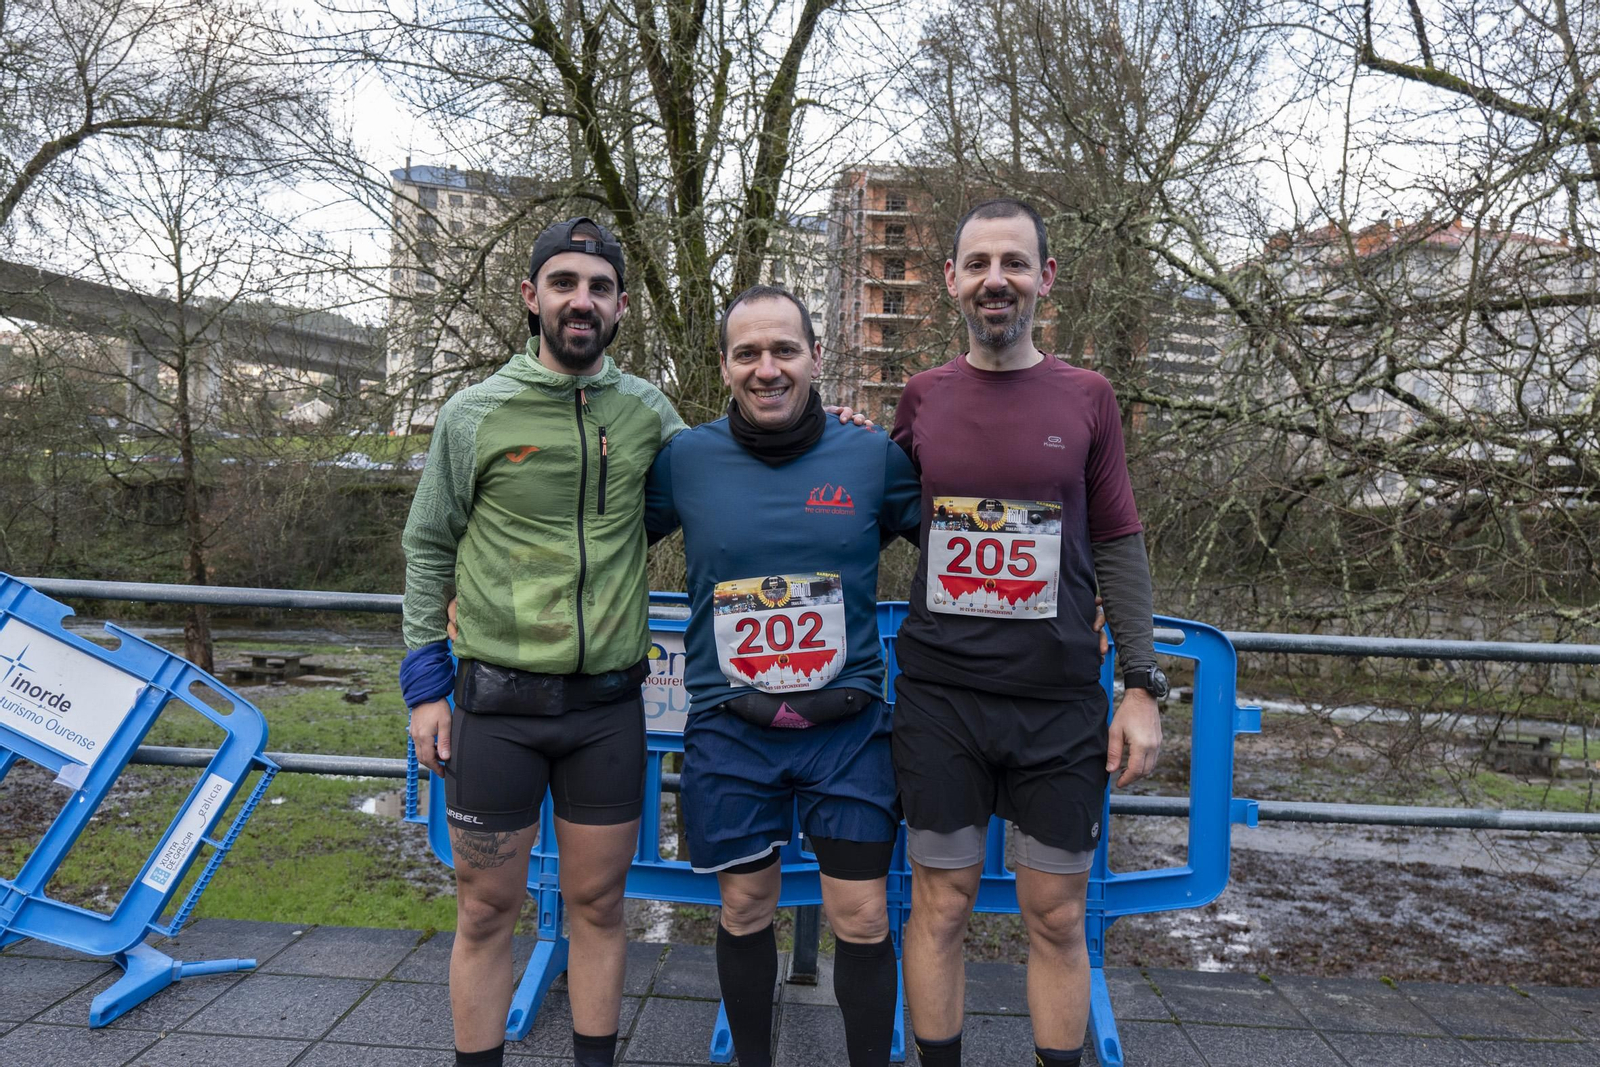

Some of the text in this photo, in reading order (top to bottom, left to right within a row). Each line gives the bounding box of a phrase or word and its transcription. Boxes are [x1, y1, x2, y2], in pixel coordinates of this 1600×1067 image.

[946, 536, 1037, 578] 205
[736, 612, 826, 654] 202
[10, 672, 72, 713] inorde
[45, 718, 96, 750] Ourense
[198, 784, 222, 828] galicia
[446, 807, 483, 824] URBEL
[160, 841, 179, 866] XUNTA
[166, 831, 193, 870] DE GALICIA
